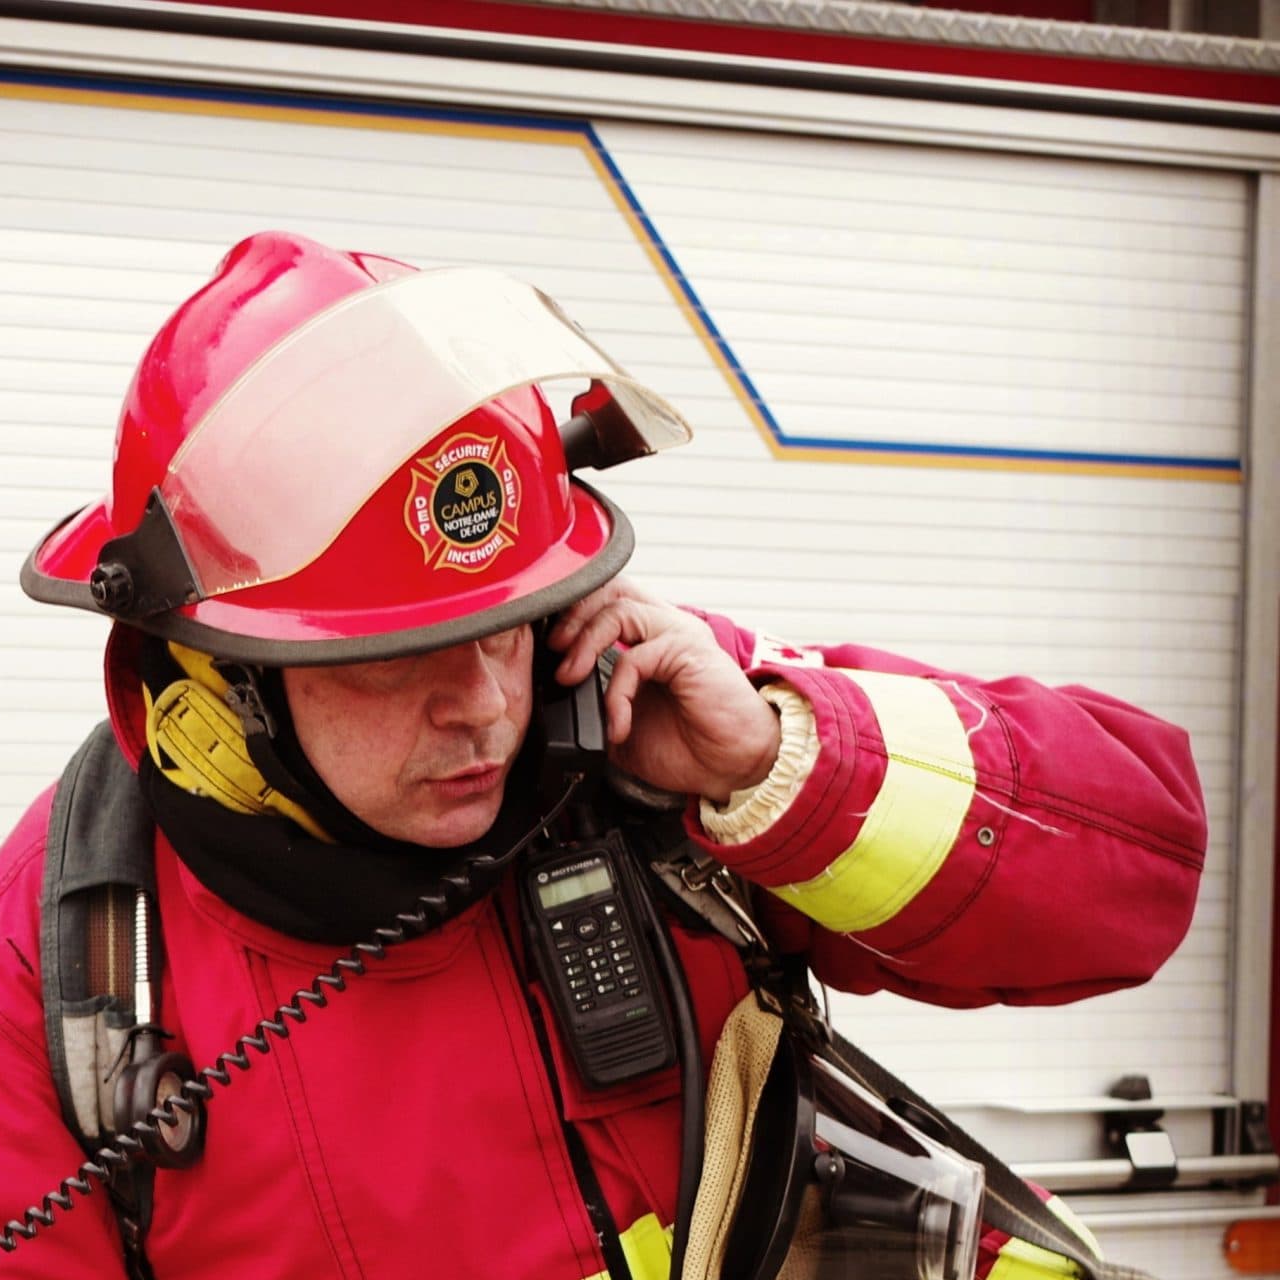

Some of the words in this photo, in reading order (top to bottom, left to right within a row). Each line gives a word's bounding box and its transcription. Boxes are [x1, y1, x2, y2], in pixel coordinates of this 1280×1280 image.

[503, 469, 517, 508] DEC
[415, 496, 430, 536] DEP
[441, 491, 497, 521] CAMPUS
[447, 535, 504, 564] INCENDIE
[551, 857, 601, 877] MOTOROLA
